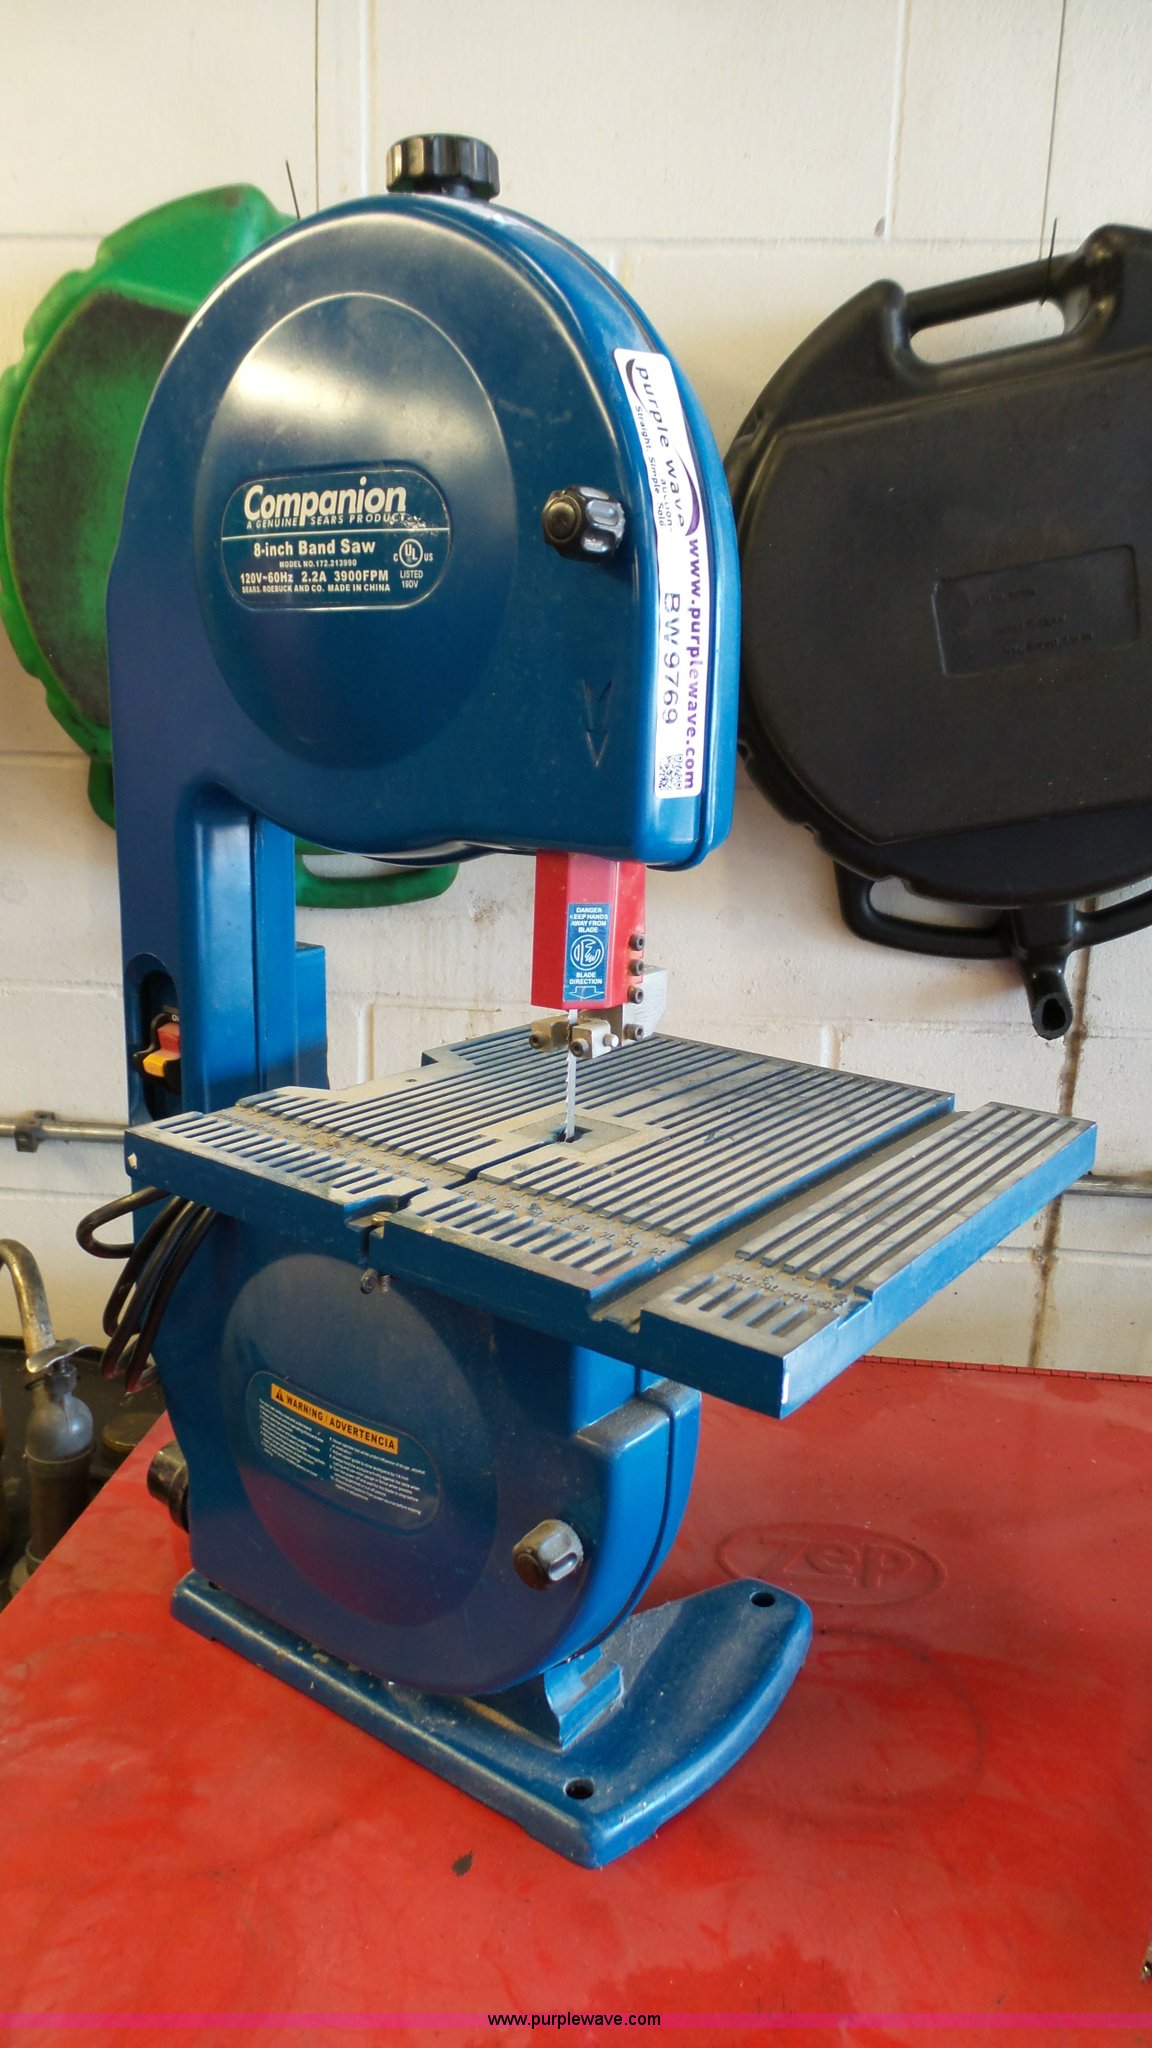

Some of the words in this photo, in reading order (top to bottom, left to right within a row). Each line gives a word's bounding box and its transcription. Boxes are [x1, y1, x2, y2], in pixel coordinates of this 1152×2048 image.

[635, 365, 670, 448] purple
[244, 476, 407, 526] Companion
[246, 520, 252, 529] A
[255, 517, 298, 528] GENUINE
[310, 514, 344, 525] SEARS
[349, 513, 406, 524] PRODUCT
[253, 541, 294, 557] 8-inch
[298, 539, 336, 555] Band
[340, 538, 376, 553] Saw
[279, 560, 302, 568] MODEL
[423, 552, 433, 562] US
[301, 570, 327, 582] 2.2A
[334, 569, 389, 582] 3900FPM
[400, 570, 424, 579] LISTED
[262, 584, 293, 592] ROEBUCK
[294, 584, 310, 592] AND
[310, 584, 325, 592] CO.
[327, 583, 351, 592] MADE
[352, 583, 362, 592] IN
[363, 583, 391, 592] CHINA
[663, 592, 681, 725] BW9769
[684, 539, 703, 790] www.purplewave.com
[286, 1394, 323, 1421] WARNING
[329, 1417, 395, 1450] ADVERTENCIA
